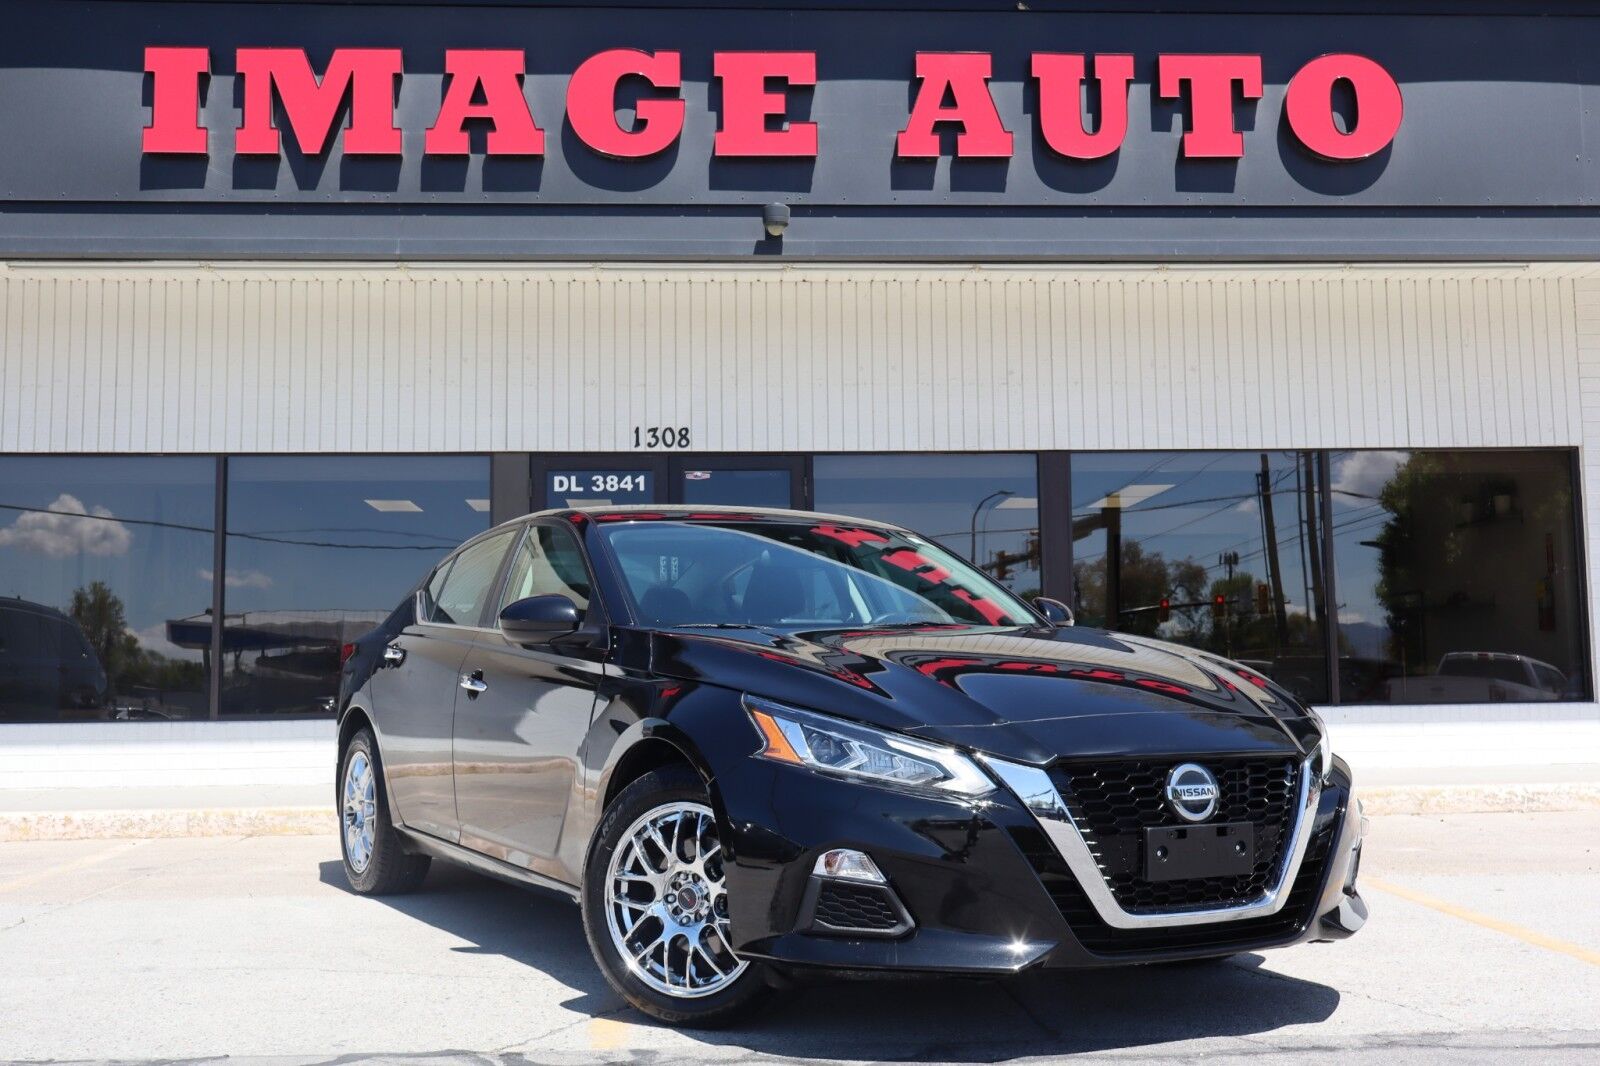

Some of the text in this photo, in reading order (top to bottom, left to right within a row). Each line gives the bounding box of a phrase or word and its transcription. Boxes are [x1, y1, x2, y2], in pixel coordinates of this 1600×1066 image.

[142, 46, 1403, 160] IMAGE AUTO
[633, 426, 690, 448] 1308
[553, 475, 645, 492] DL 3841
[1172, 787, 1214, 798] NISSAN
